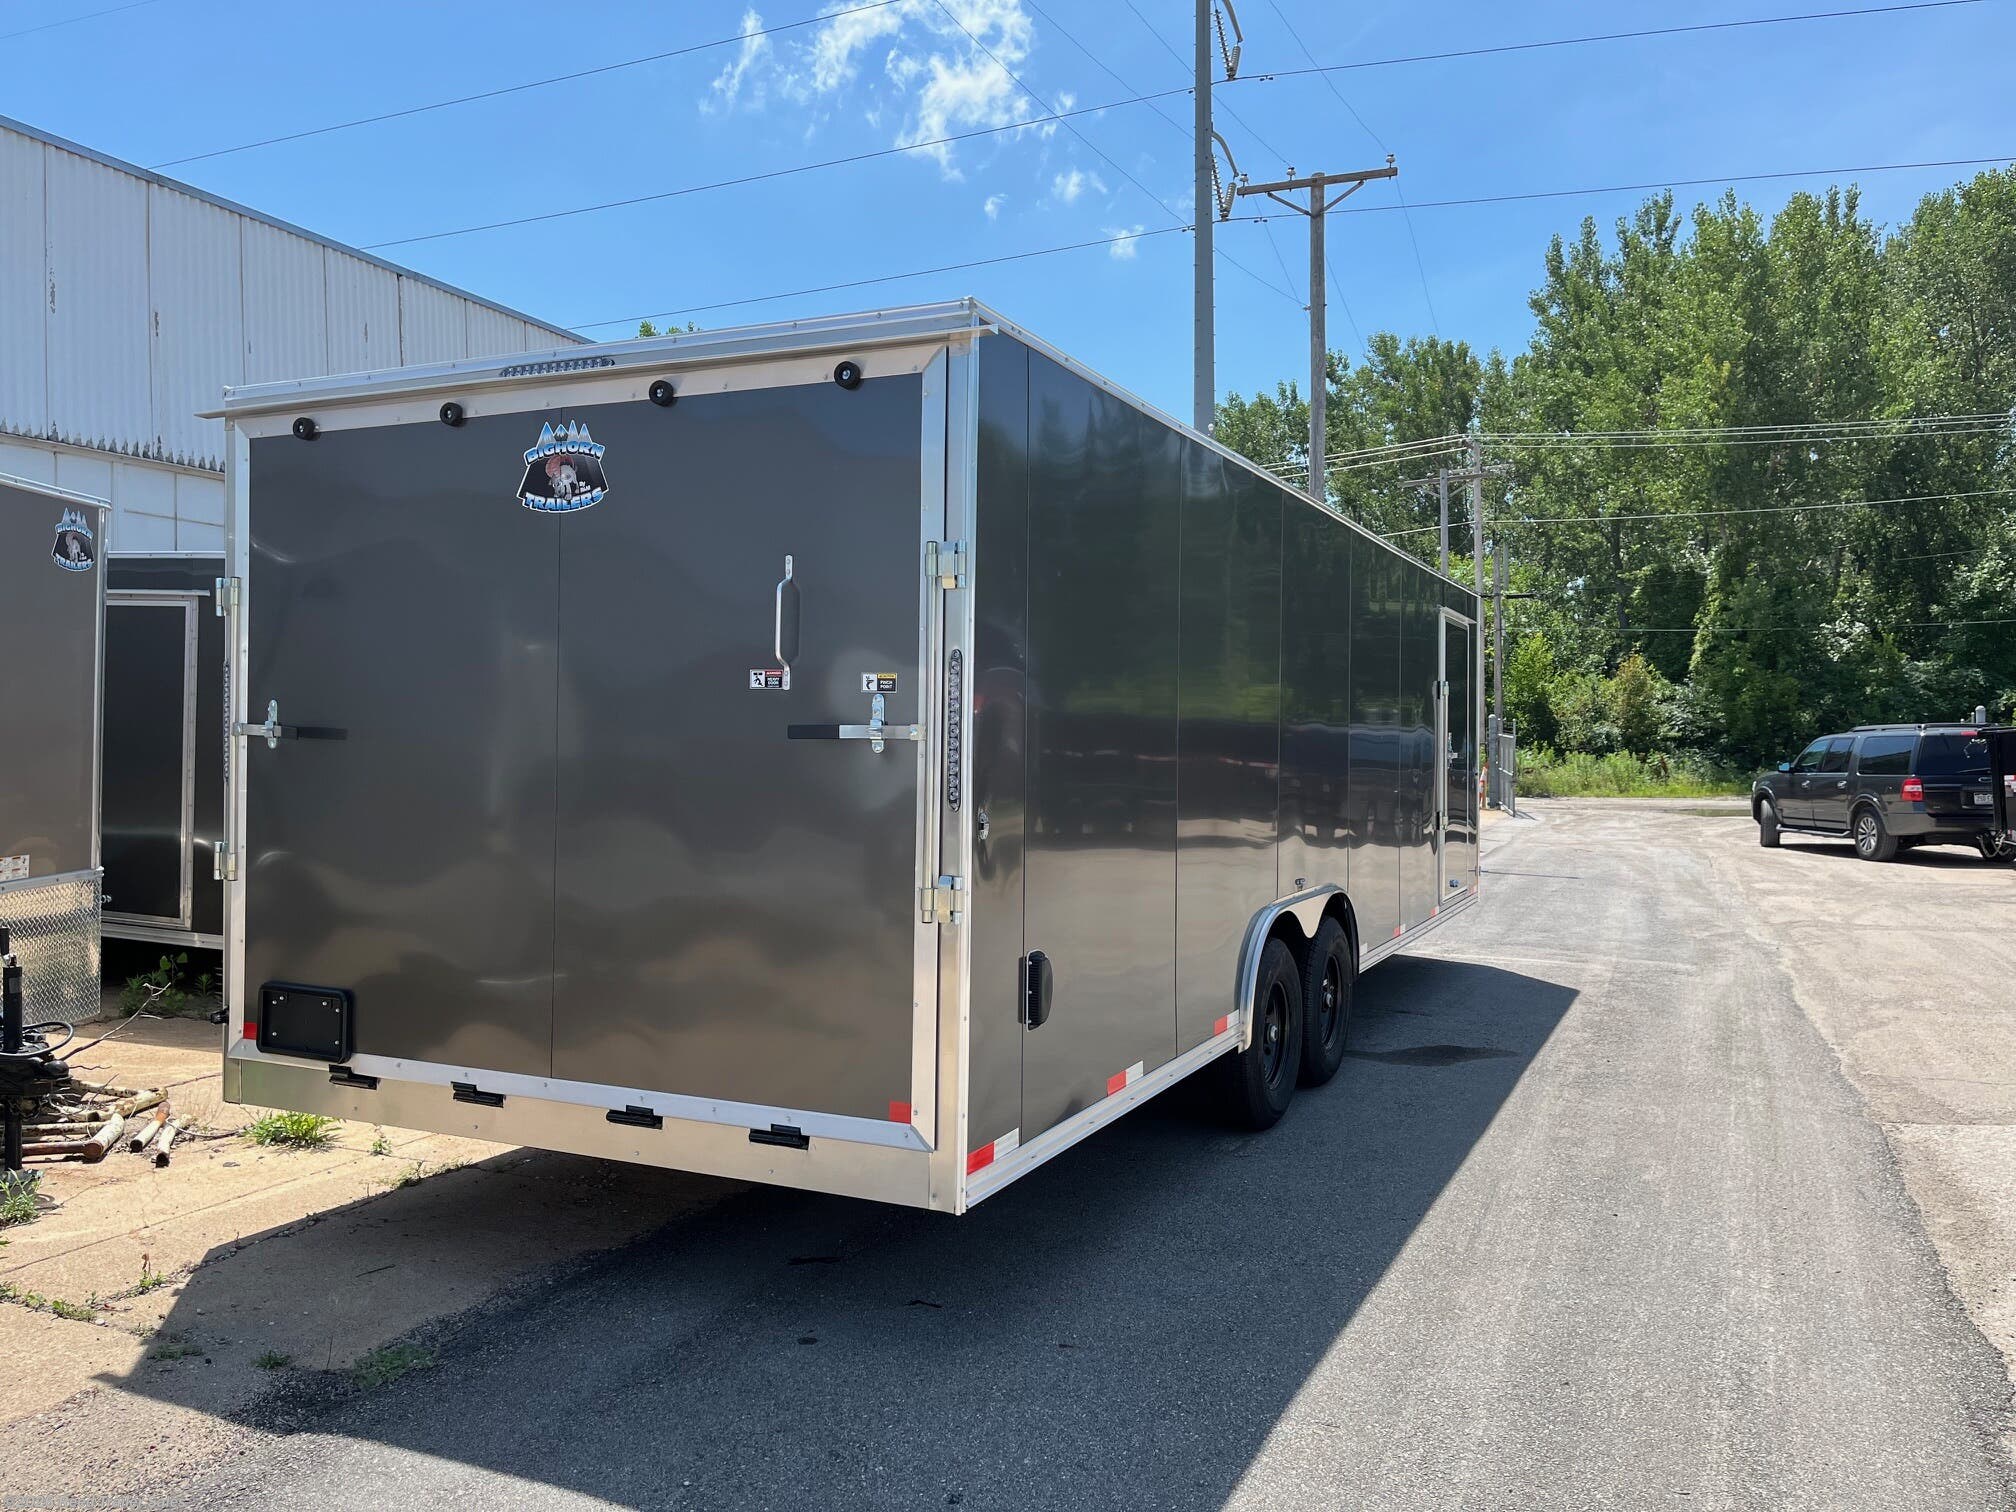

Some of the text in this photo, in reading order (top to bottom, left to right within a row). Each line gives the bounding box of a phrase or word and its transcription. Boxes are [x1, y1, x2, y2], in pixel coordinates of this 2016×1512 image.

[525, 441, 605, 463] BIGHORN
[525, 487, 603, 510] TRAILERS
[56, 523, 93, 540] BIGHORN
[55, 552, 93, 570] TRAILERS
